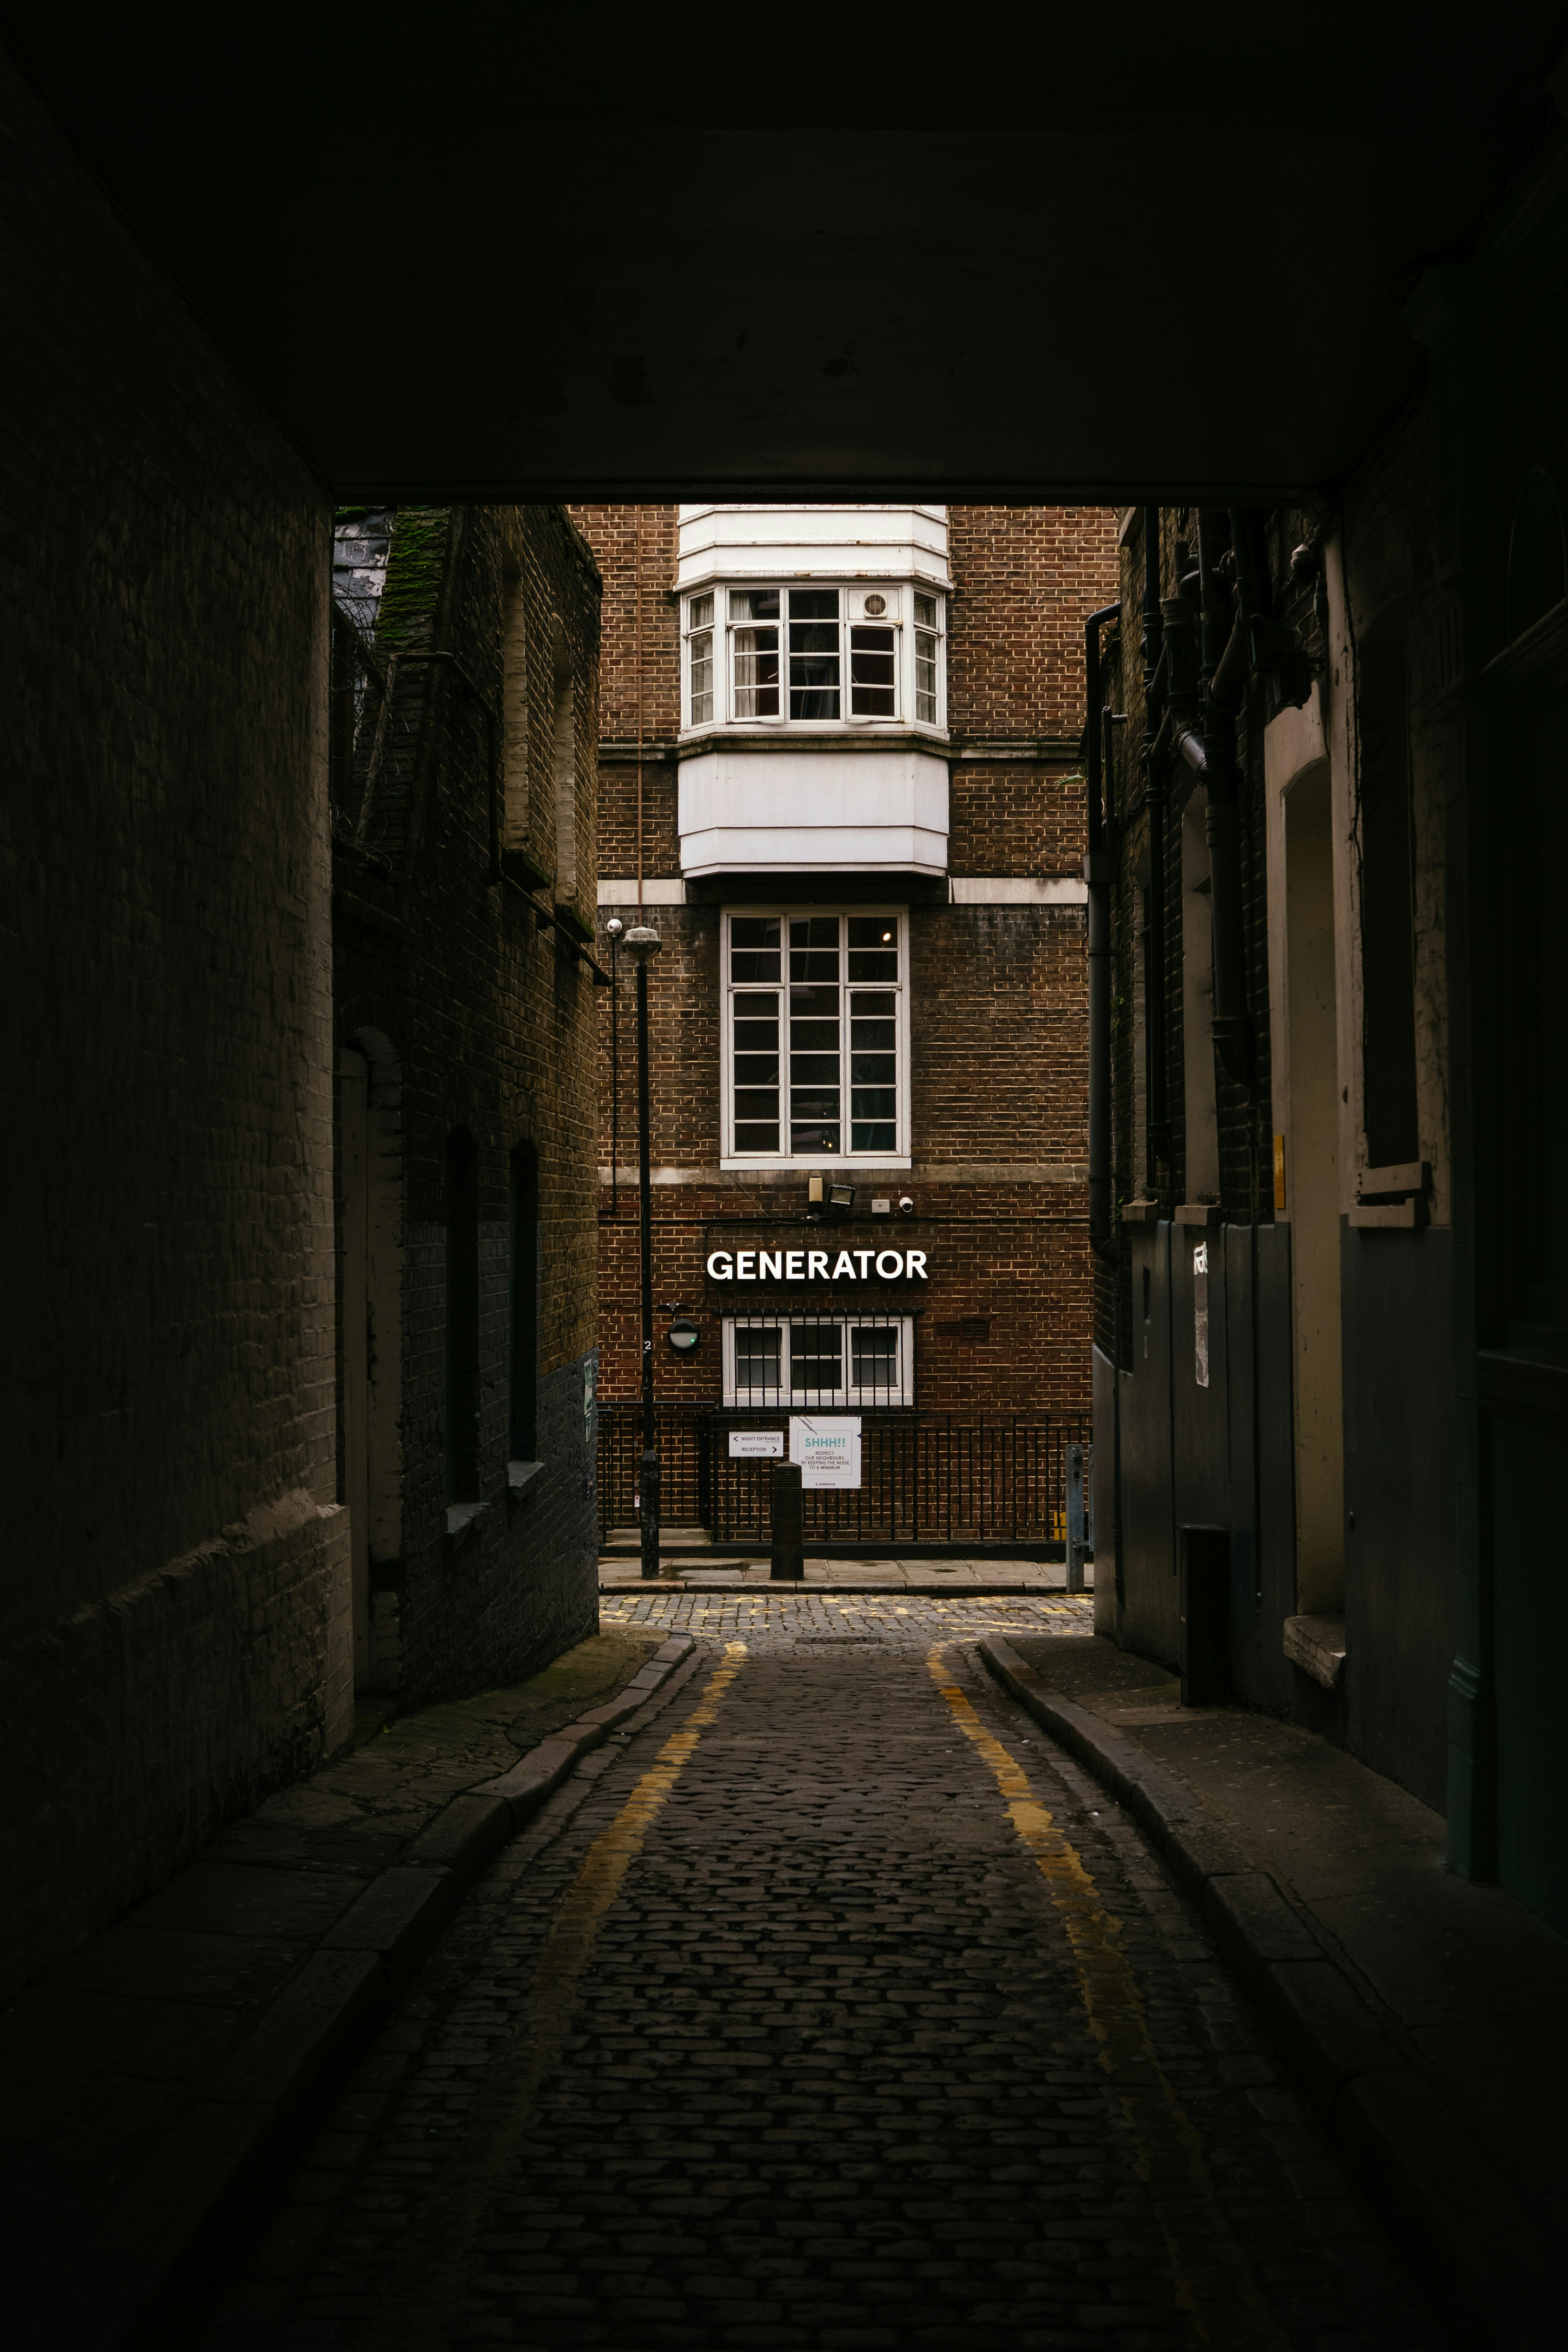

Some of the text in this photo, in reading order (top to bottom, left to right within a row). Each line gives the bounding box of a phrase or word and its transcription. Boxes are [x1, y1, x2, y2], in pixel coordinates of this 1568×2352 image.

[708, 1251, 928, 1279] GENERATOR
[645, 1341, 651, 1349] 2
[805, 1438, 845, 1447] SHHH!!
